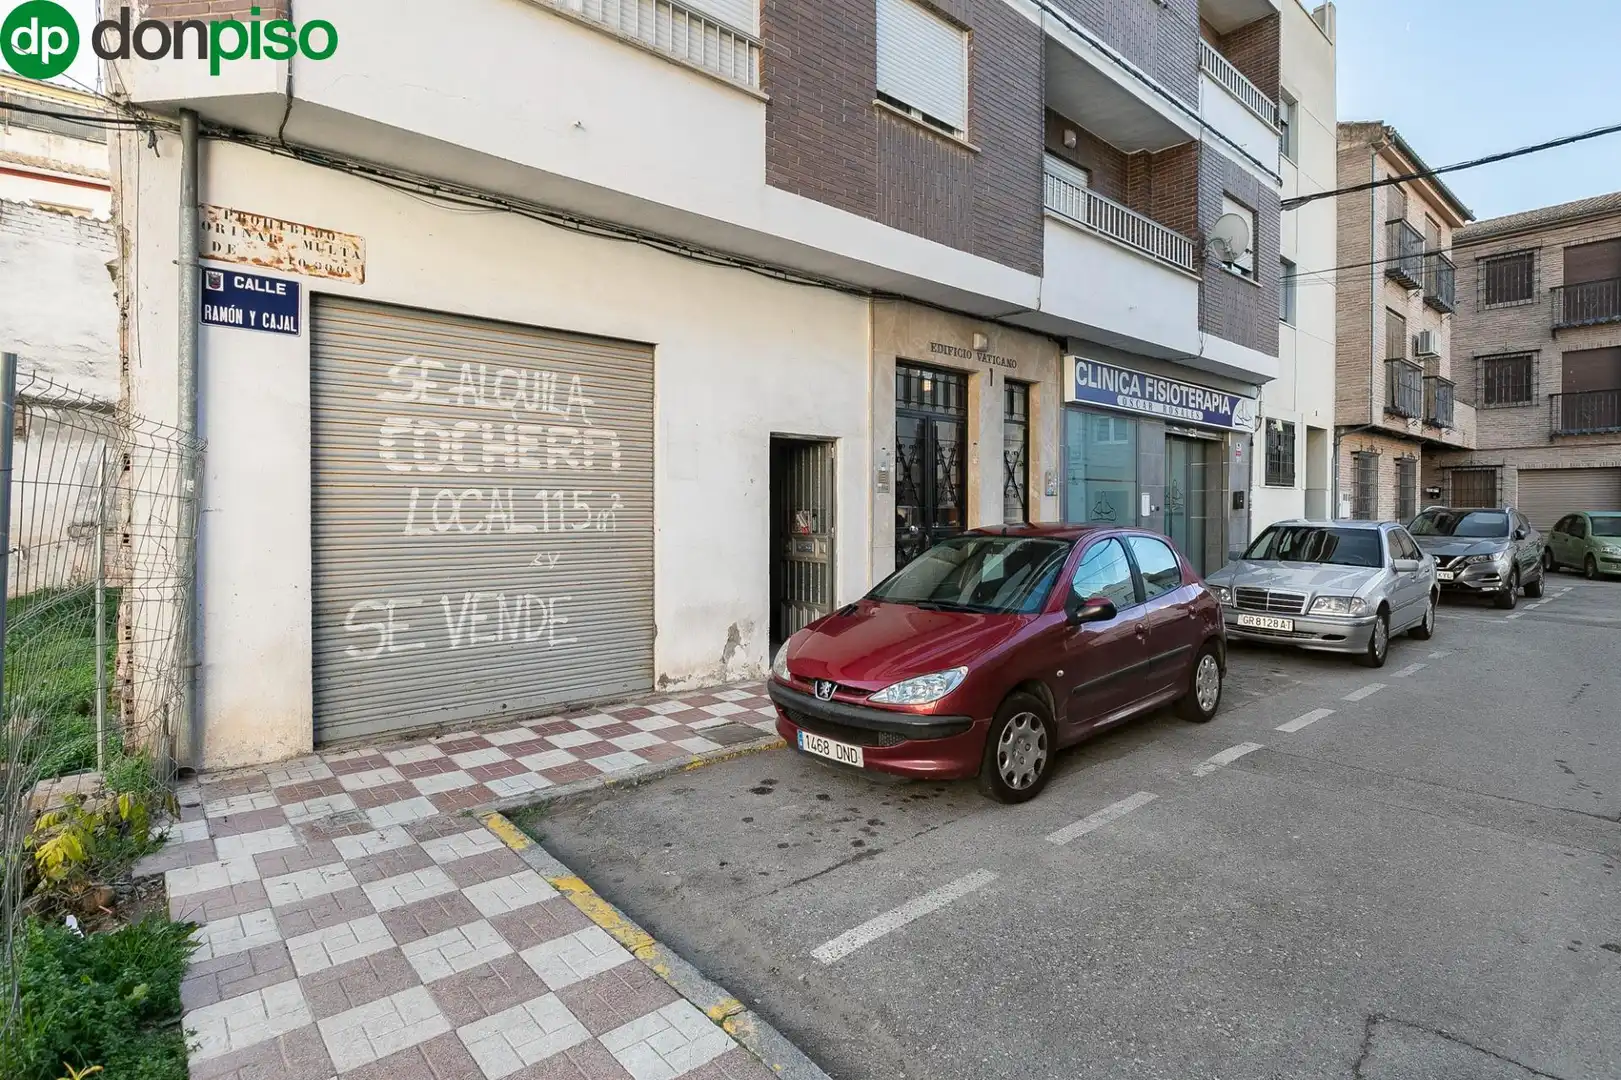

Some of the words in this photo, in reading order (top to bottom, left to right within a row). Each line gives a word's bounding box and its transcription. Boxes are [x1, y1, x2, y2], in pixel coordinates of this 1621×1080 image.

[201, 220, 279, 244] ORINAR
[302, 240, 361, 260] MULTA
[212, 241, 237, 255] DE
[233, 276, 287, 295] CALLE
[203, 304, 243, 325] RAMÓN
[249, 310, 256, 327] Y
[262, 312, 297, 333] CAJAL
[930, 342, 972, 360] EDIFICIO
[976, 352, 1017, 369] VATICANO
[375, 355, 450, 404] SE
[448, 362, 595, 426] ALQUILA
[1075, 361, 1141, 398] CLINICA
[1145, 377, 1231, 416] FISIOTERAPIA
[1122, 397, 1153, 411] OSCAR
[1163, 405, 1200, 420] ROSALES
[402, 487, 537, 536] LOCAL
[343, 598, 426, 660] SE
[440, 591, 578, 651] VENDE
[805, 734, 830, 755] 1468
[836, 744, 858, 764] DND
